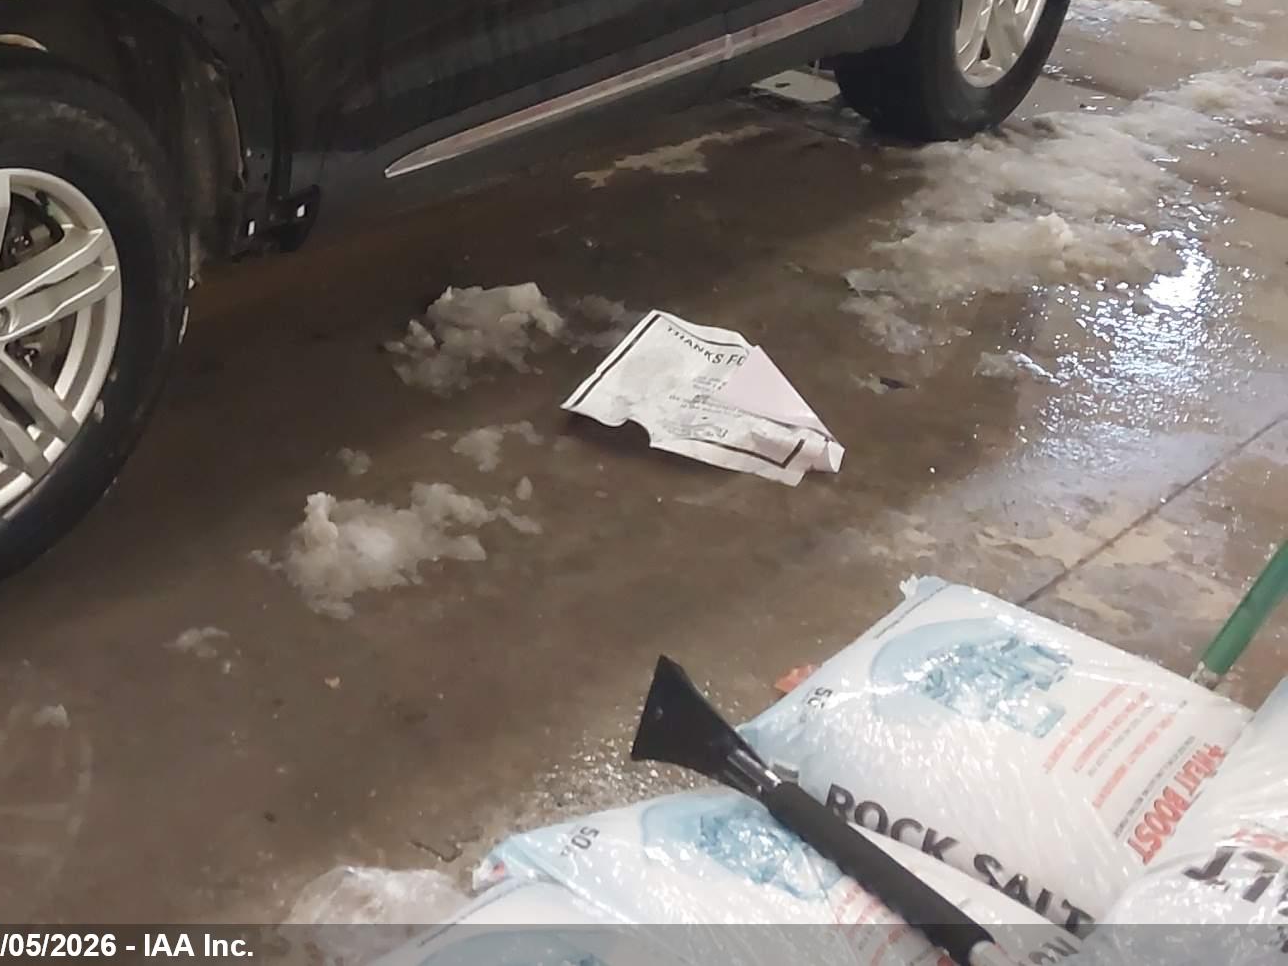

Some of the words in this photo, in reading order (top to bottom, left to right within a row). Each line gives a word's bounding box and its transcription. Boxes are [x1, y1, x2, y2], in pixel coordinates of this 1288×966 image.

[667, 324, 724, 364] THANKS
[571, 826, 600, 849] 50
[1127, 786, 1191, 864] BOOST
[825, 783, 959, 861] ROCK
[973, 853, 1095, 940] SALT
